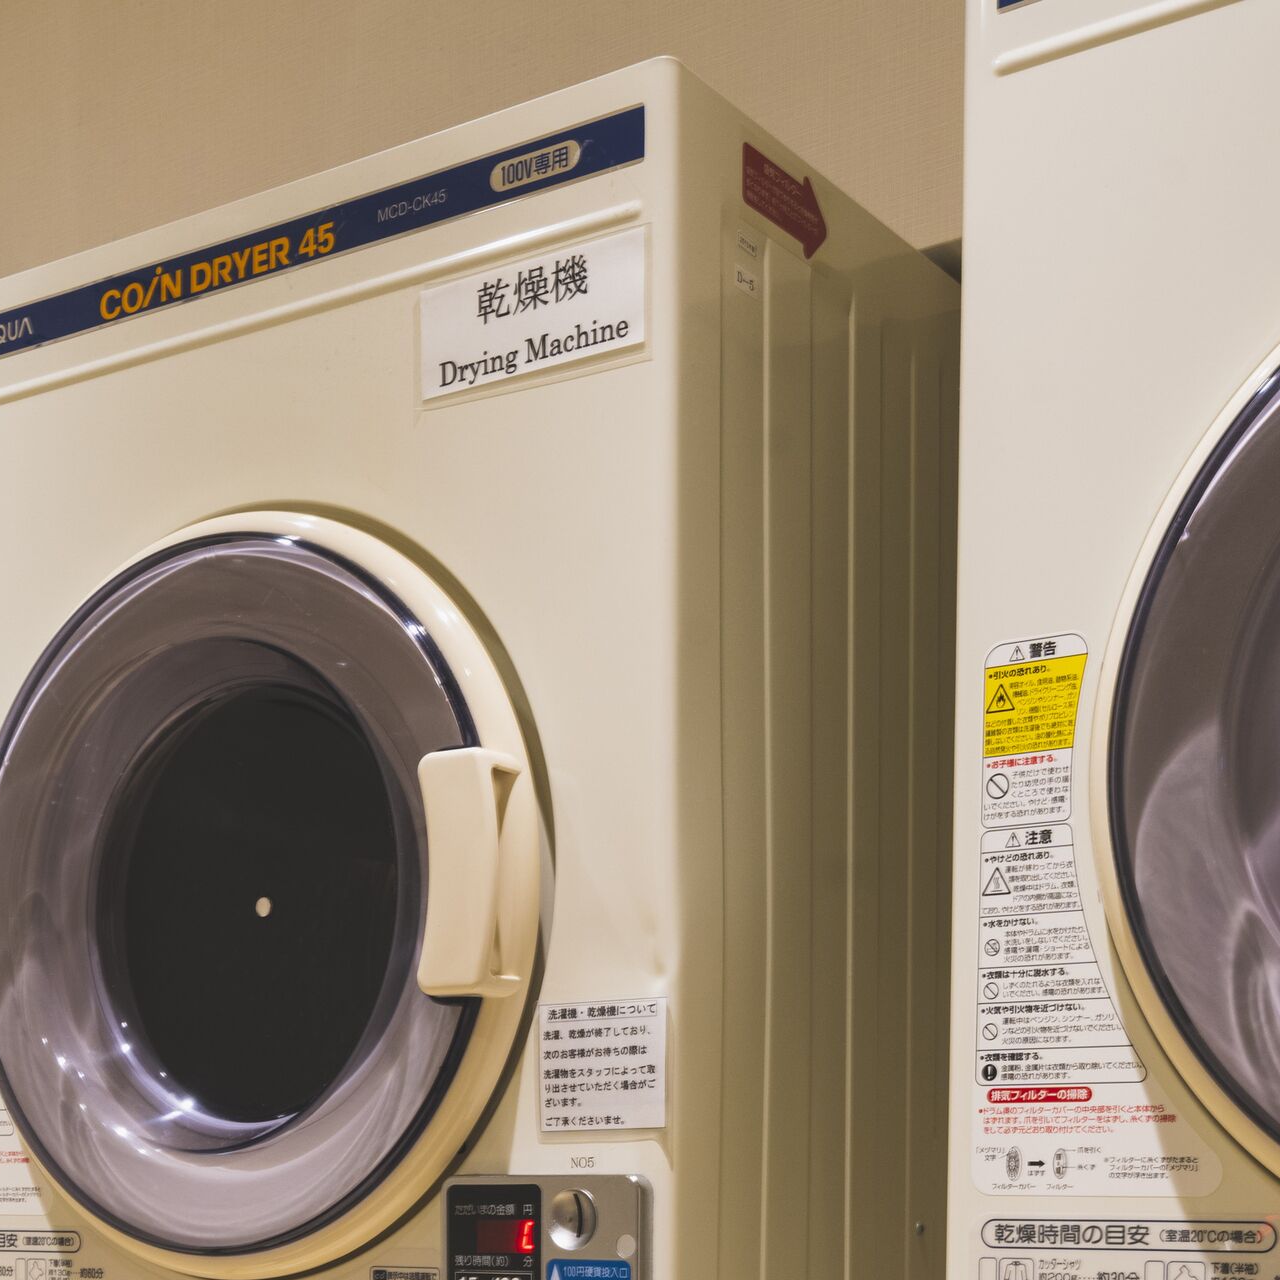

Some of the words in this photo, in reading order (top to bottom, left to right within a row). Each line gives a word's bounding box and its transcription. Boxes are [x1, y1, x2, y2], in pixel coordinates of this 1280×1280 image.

[500, 145, 569, 187] 100V専用
[377, 189, 446, 223] MCD-CK45
[190, 237, 290, 293] DRYER
[299, 222, 334, 257] 45
[476, 254, 588, 325] 乾燥機
[439, 346, 518, 388] Drying
[524, 319, 629, 364] Machine
[1029, 641, 1056, 658] 警告
[1025, 829, 1052, 845] 注意
[548, 1004, 656, 1020] 洗濯機・乾燥機について
[543, 1045, 647, 1060] 次のお客様がお待ちの際は
[543, 1064, 656, 1079] 洗濯物をスタッフによって取
[544, 1079, 656, 1093] り出させていただく場合がご
[990, 1089, 1088, 1101] 排気フィルターの掃除
[544, 1098, 582, 1108] ざいます。
[545, 1116, 625, 1127] ご了承くださいませ。
[570, 1157, 594, 1168] NO5
[522, 1204, 532, 1216] 円
[994, 1224, 1150, 1246] 乾燥時間の目安
[522, 1256, 533, 1268] 分
